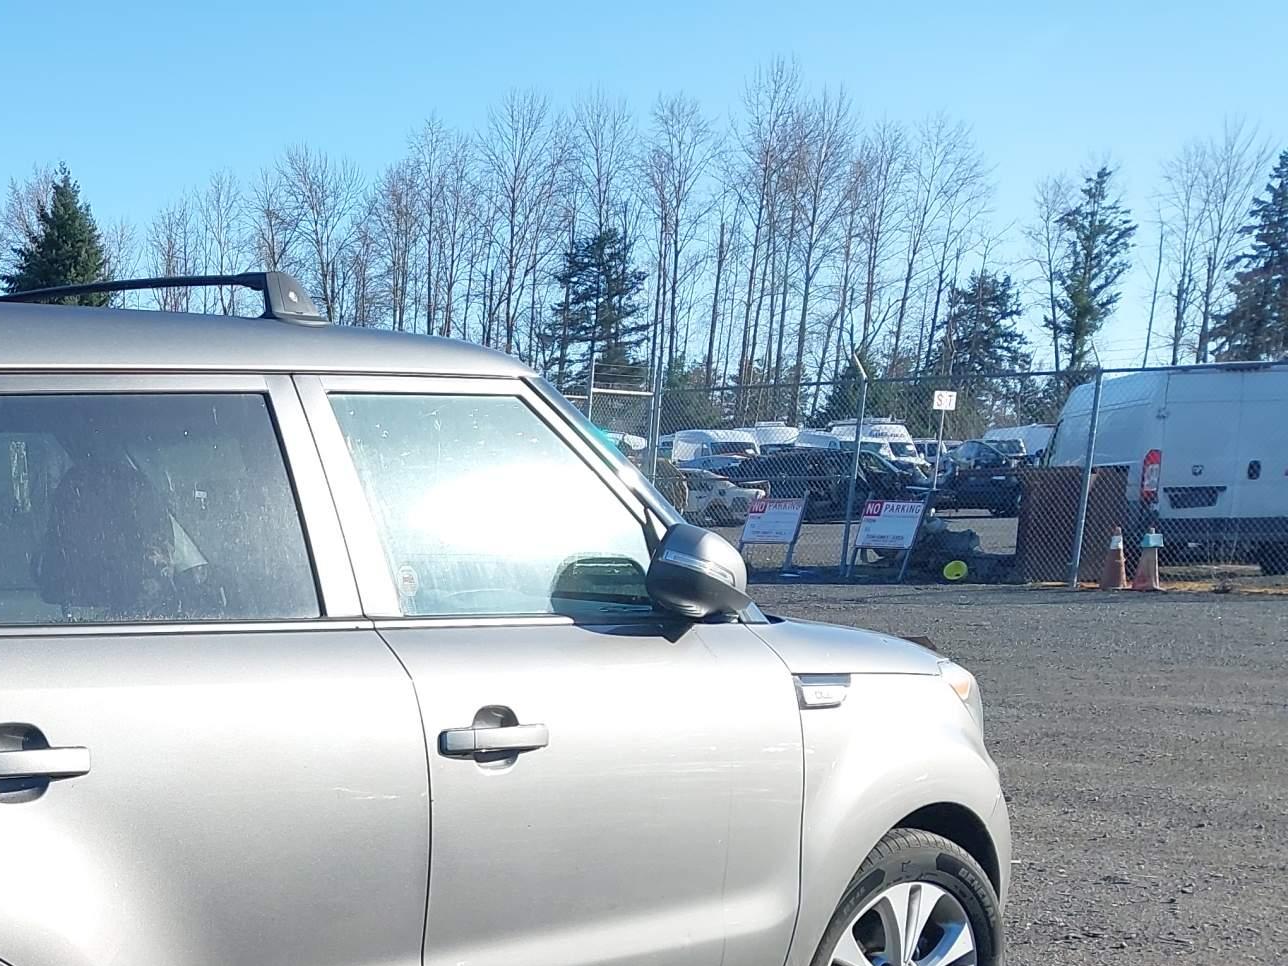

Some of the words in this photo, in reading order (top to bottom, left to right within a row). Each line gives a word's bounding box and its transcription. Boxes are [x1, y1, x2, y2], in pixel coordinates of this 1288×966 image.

[752, 501, 766, 512] NO
[865, 503, 881, 515] NO
[884, 503, 921, 514] PARKING
